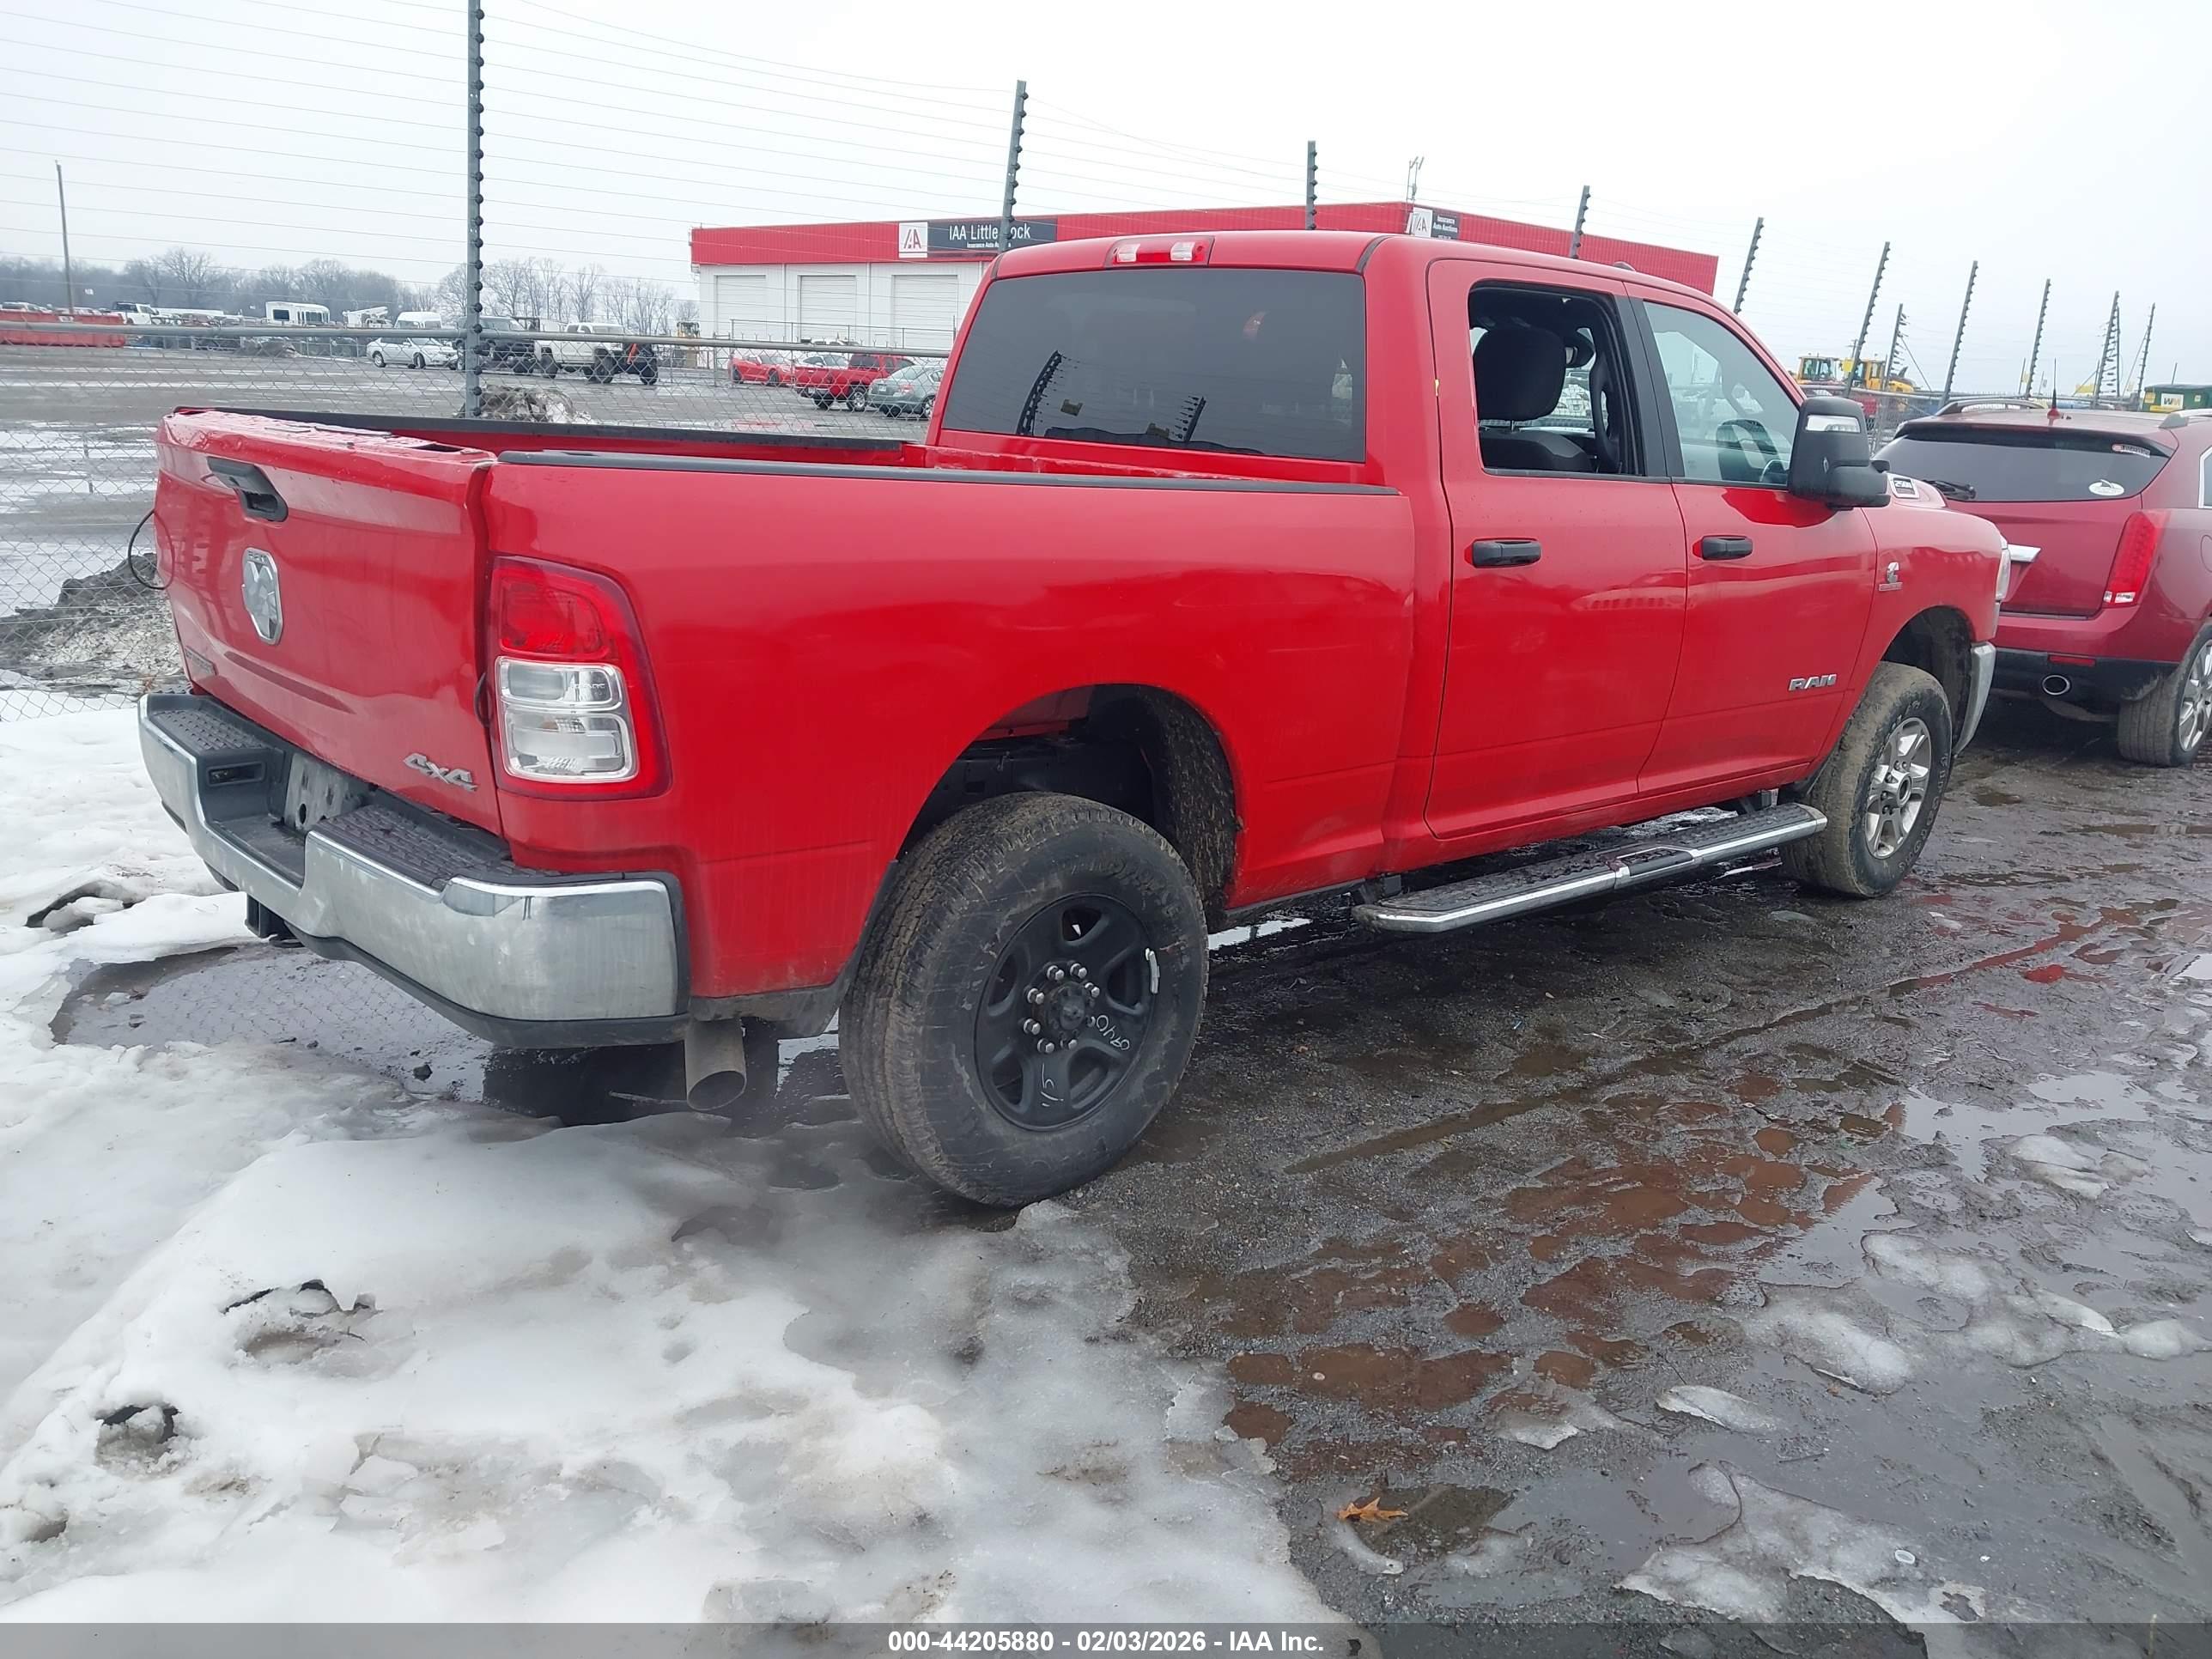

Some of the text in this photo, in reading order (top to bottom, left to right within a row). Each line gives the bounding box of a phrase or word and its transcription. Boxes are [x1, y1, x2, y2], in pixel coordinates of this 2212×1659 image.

[949, 222, 1030, 240] IAA Little ock
[1789, 674, 1837, 691] RAM
